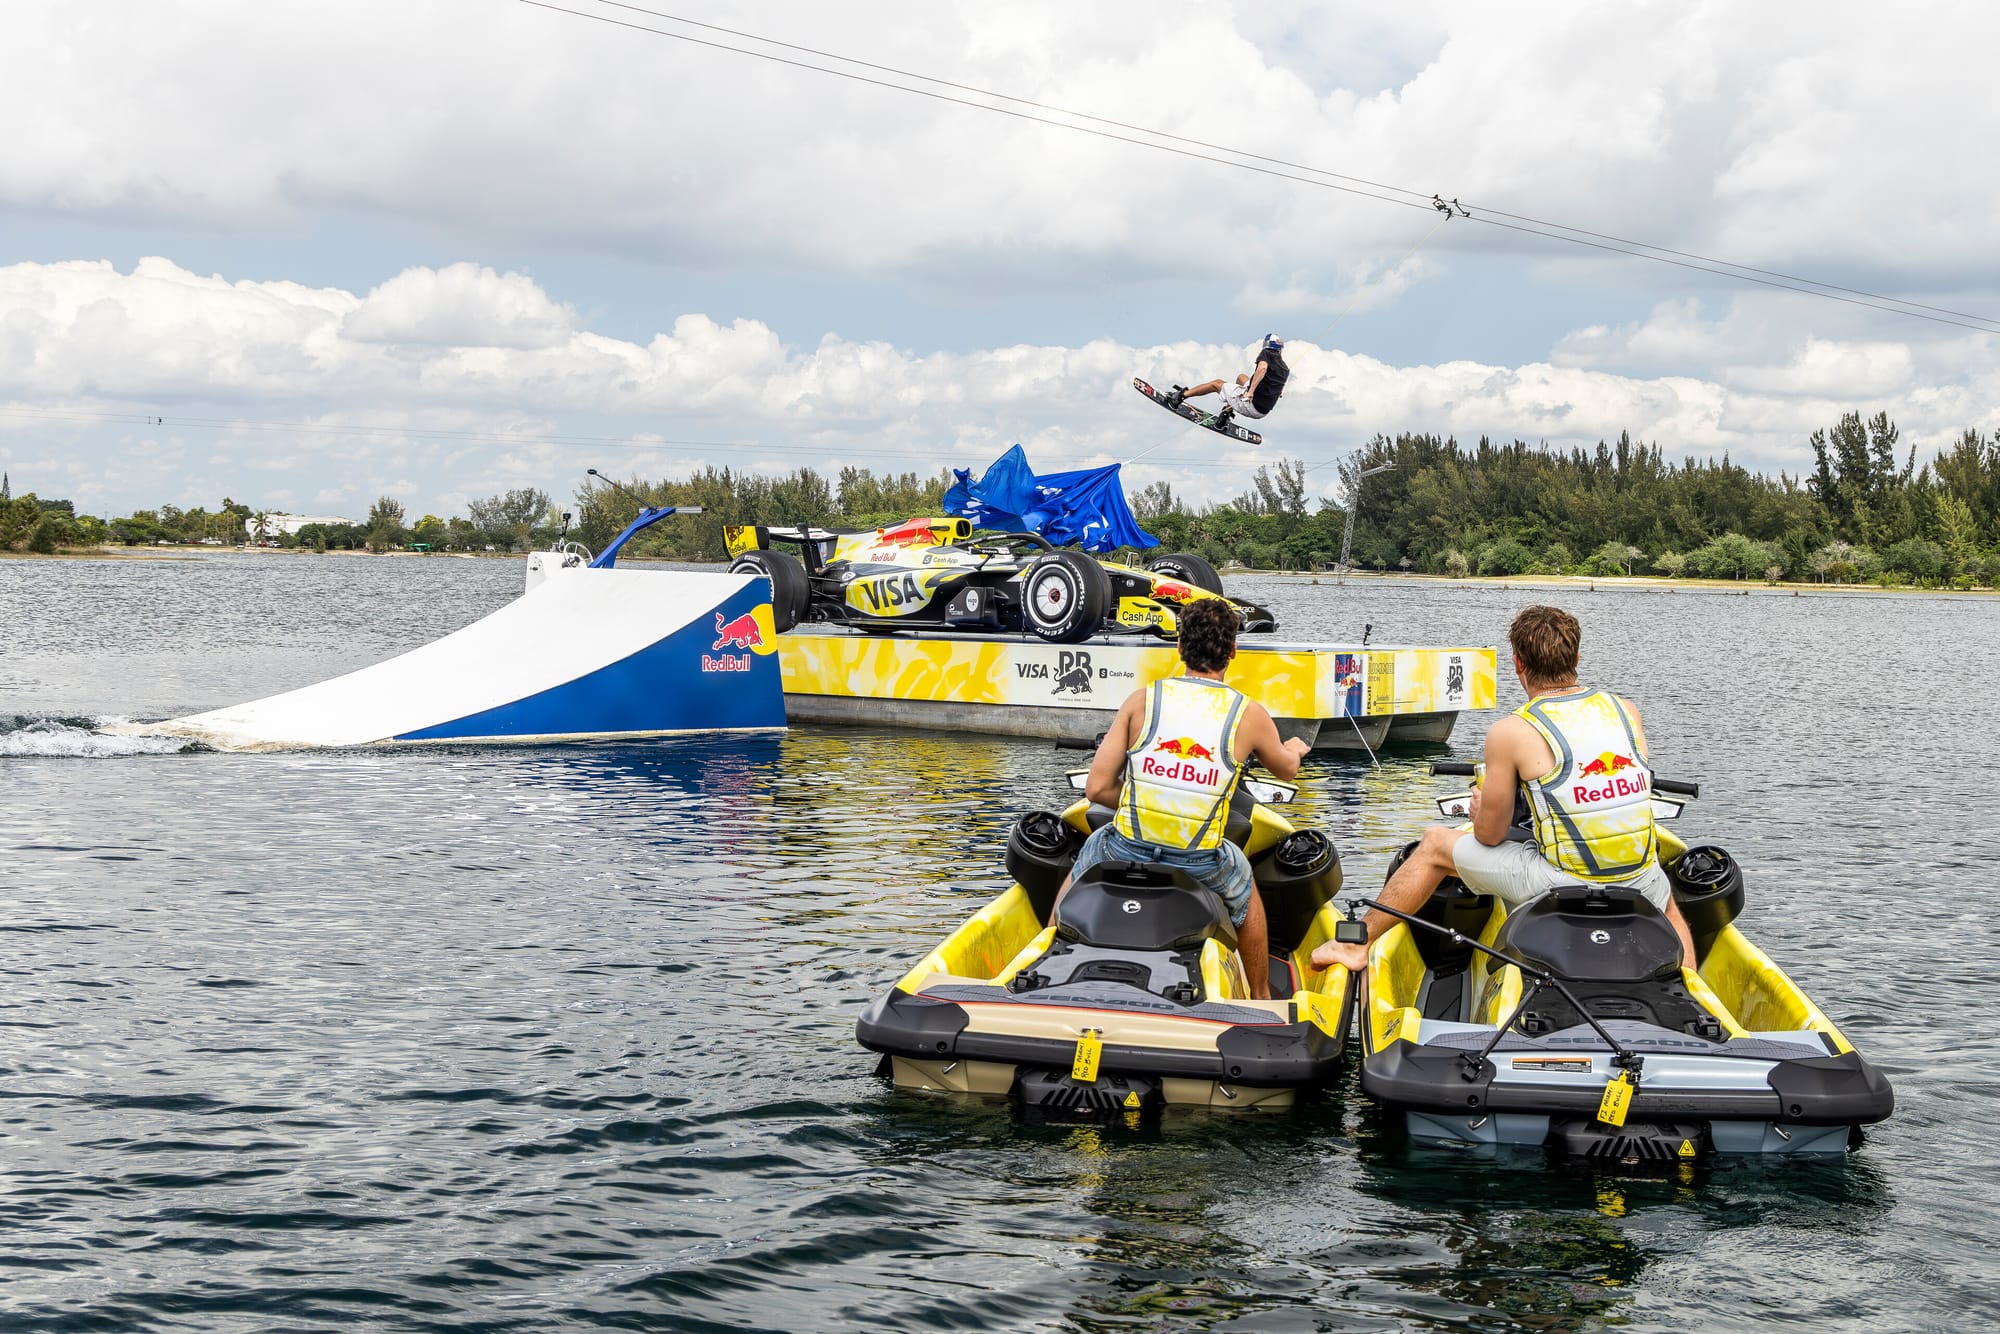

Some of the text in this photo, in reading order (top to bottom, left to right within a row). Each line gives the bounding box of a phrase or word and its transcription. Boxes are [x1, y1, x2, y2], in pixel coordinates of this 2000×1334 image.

[871, 553, 896, 562] Red Bull
[1154, 561, 1182, 570] ZERO
[860, 573, 925, 610] VISA
[1122, 611, 1163, 624] Cash App
[702, 654, 750, 672] Red Bull
[1015, 663, 1048, 678] VISA
[1142, 757, 1219, 786] Red Bull
[1573, 772, 1647, 804] Red Bull
